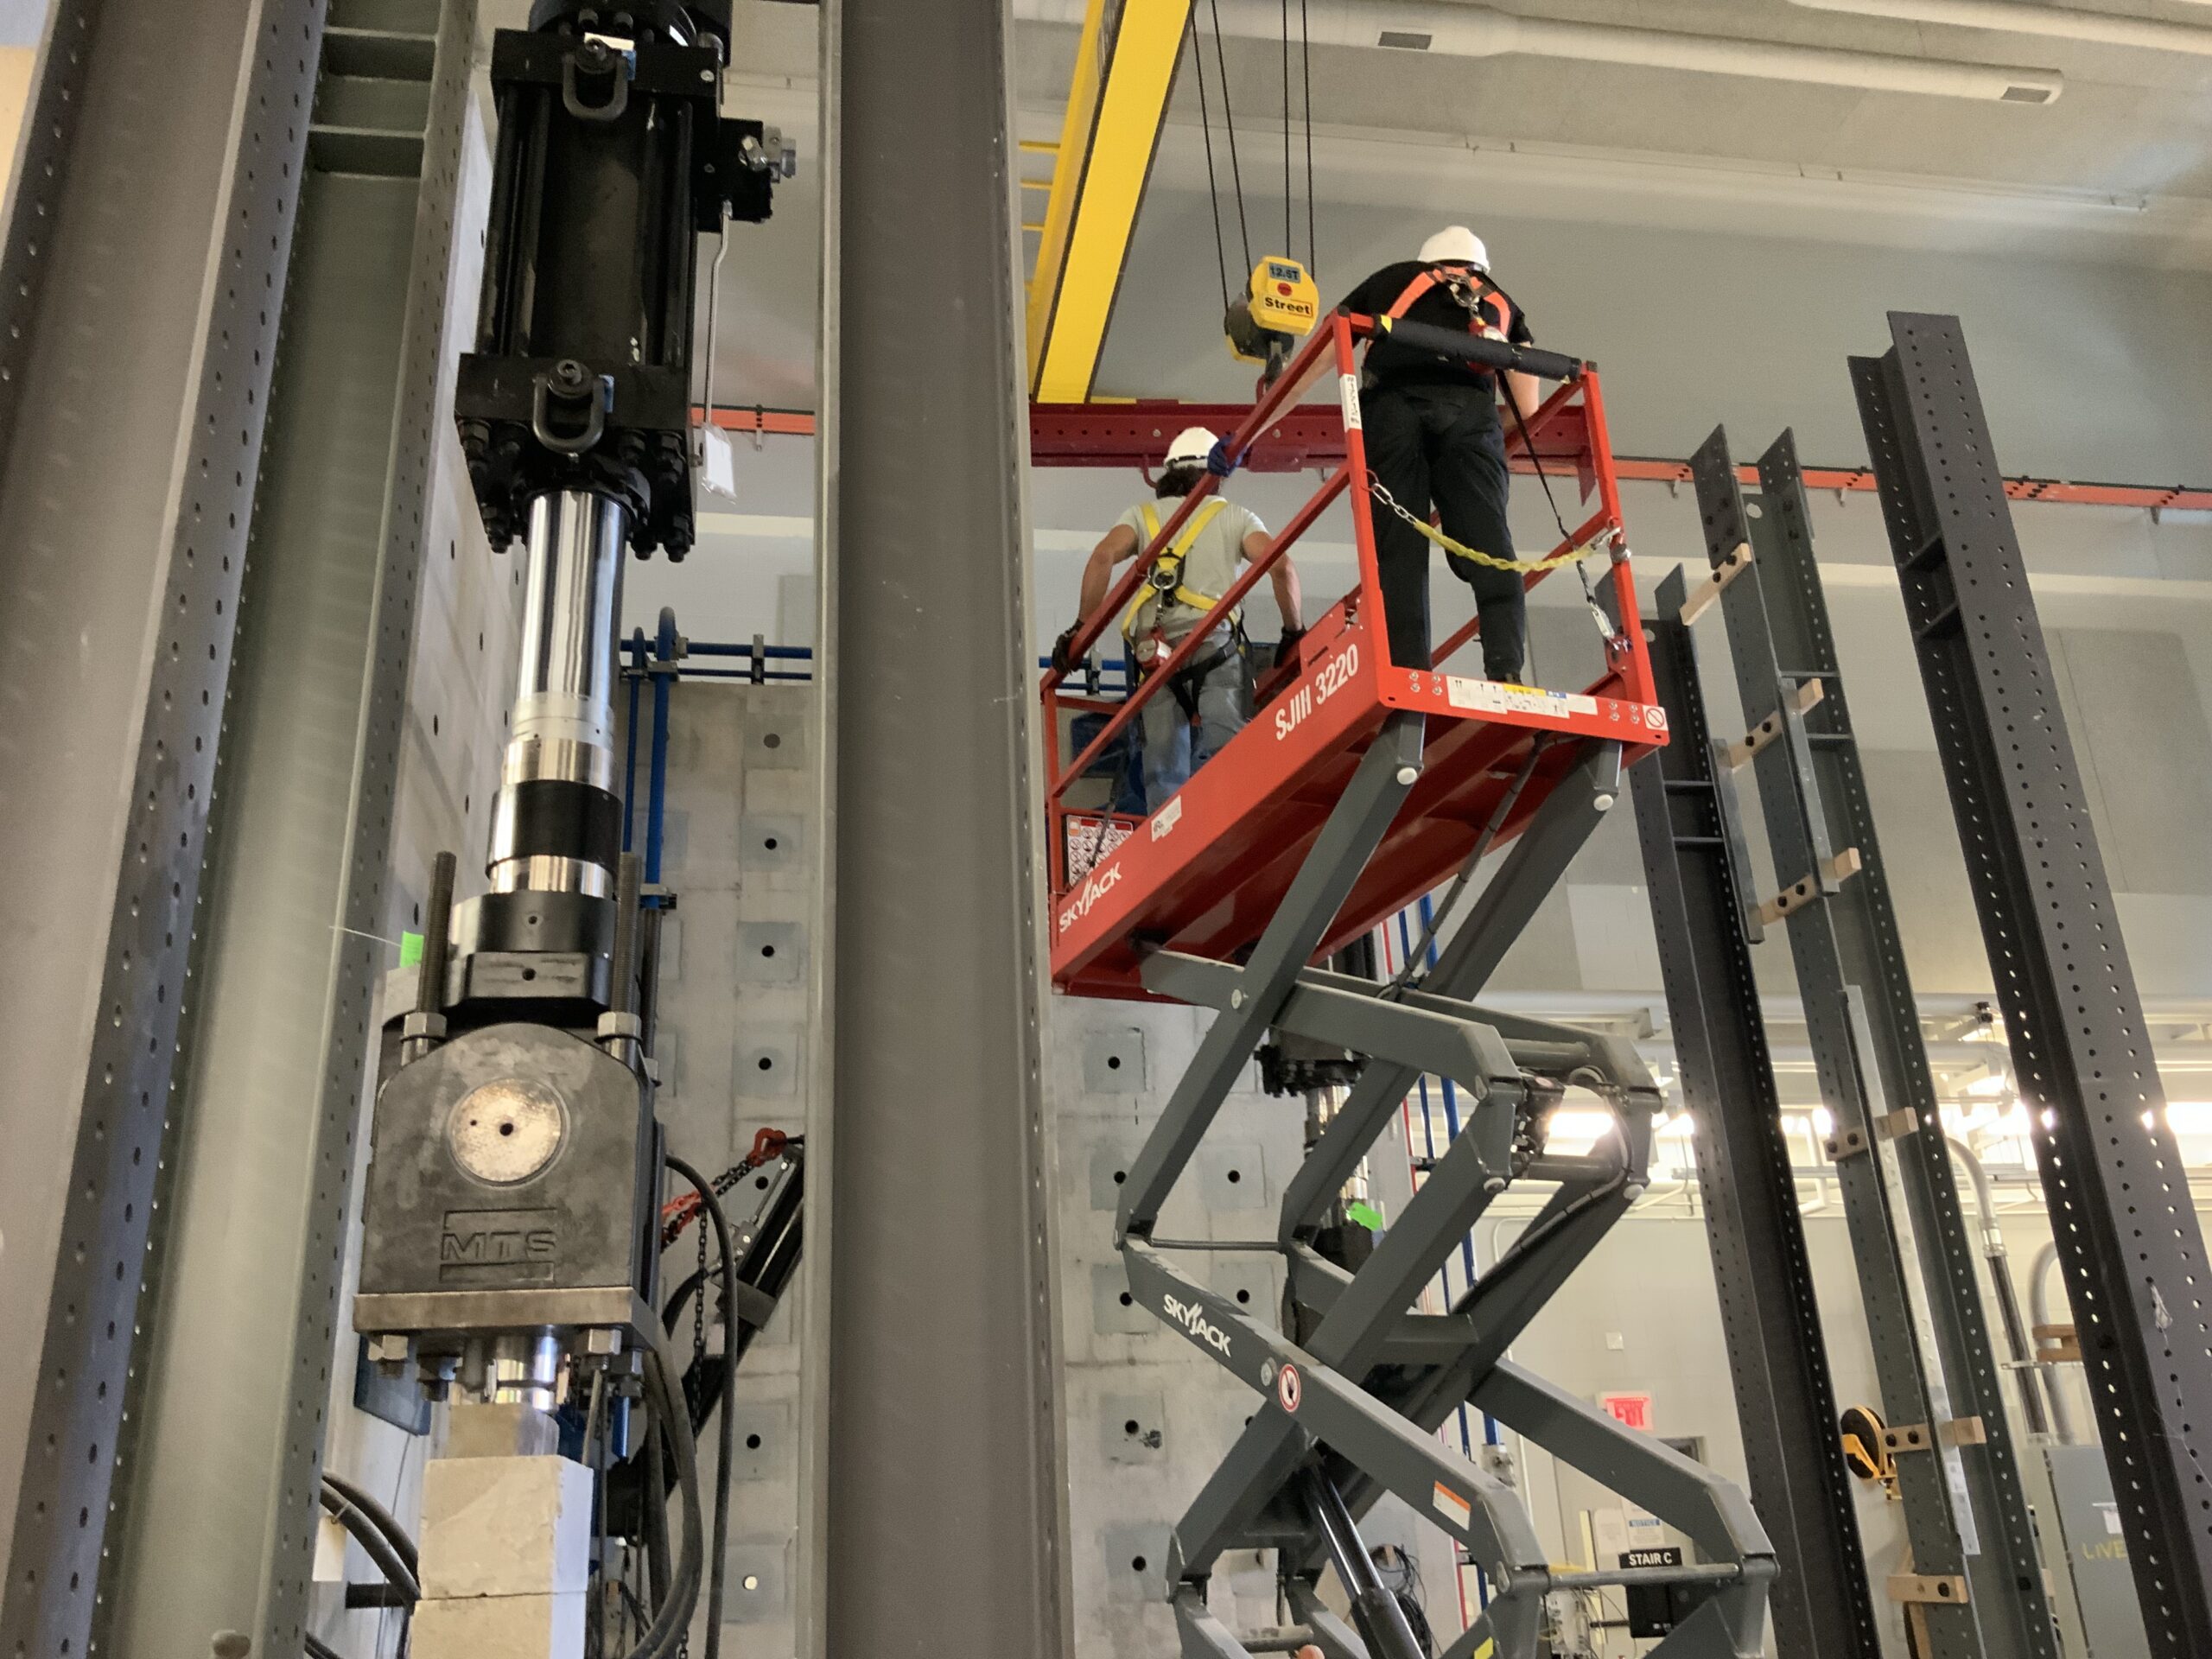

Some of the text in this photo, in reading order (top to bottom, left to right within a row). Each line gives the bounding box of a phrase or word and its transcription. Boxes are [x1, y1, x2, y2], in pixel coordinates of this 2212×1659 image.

[1265, 296, 1311, 315] Street
[1315, 643, 1358, 705] 3220
[1059, 861, 1122, 933] SKYJACK
[441, 1230, 556, 1262] MTS
[1163, 1294, 1231, 1358] SKYJACK
[1629, 1553, 1673, 1566] STAIR C
